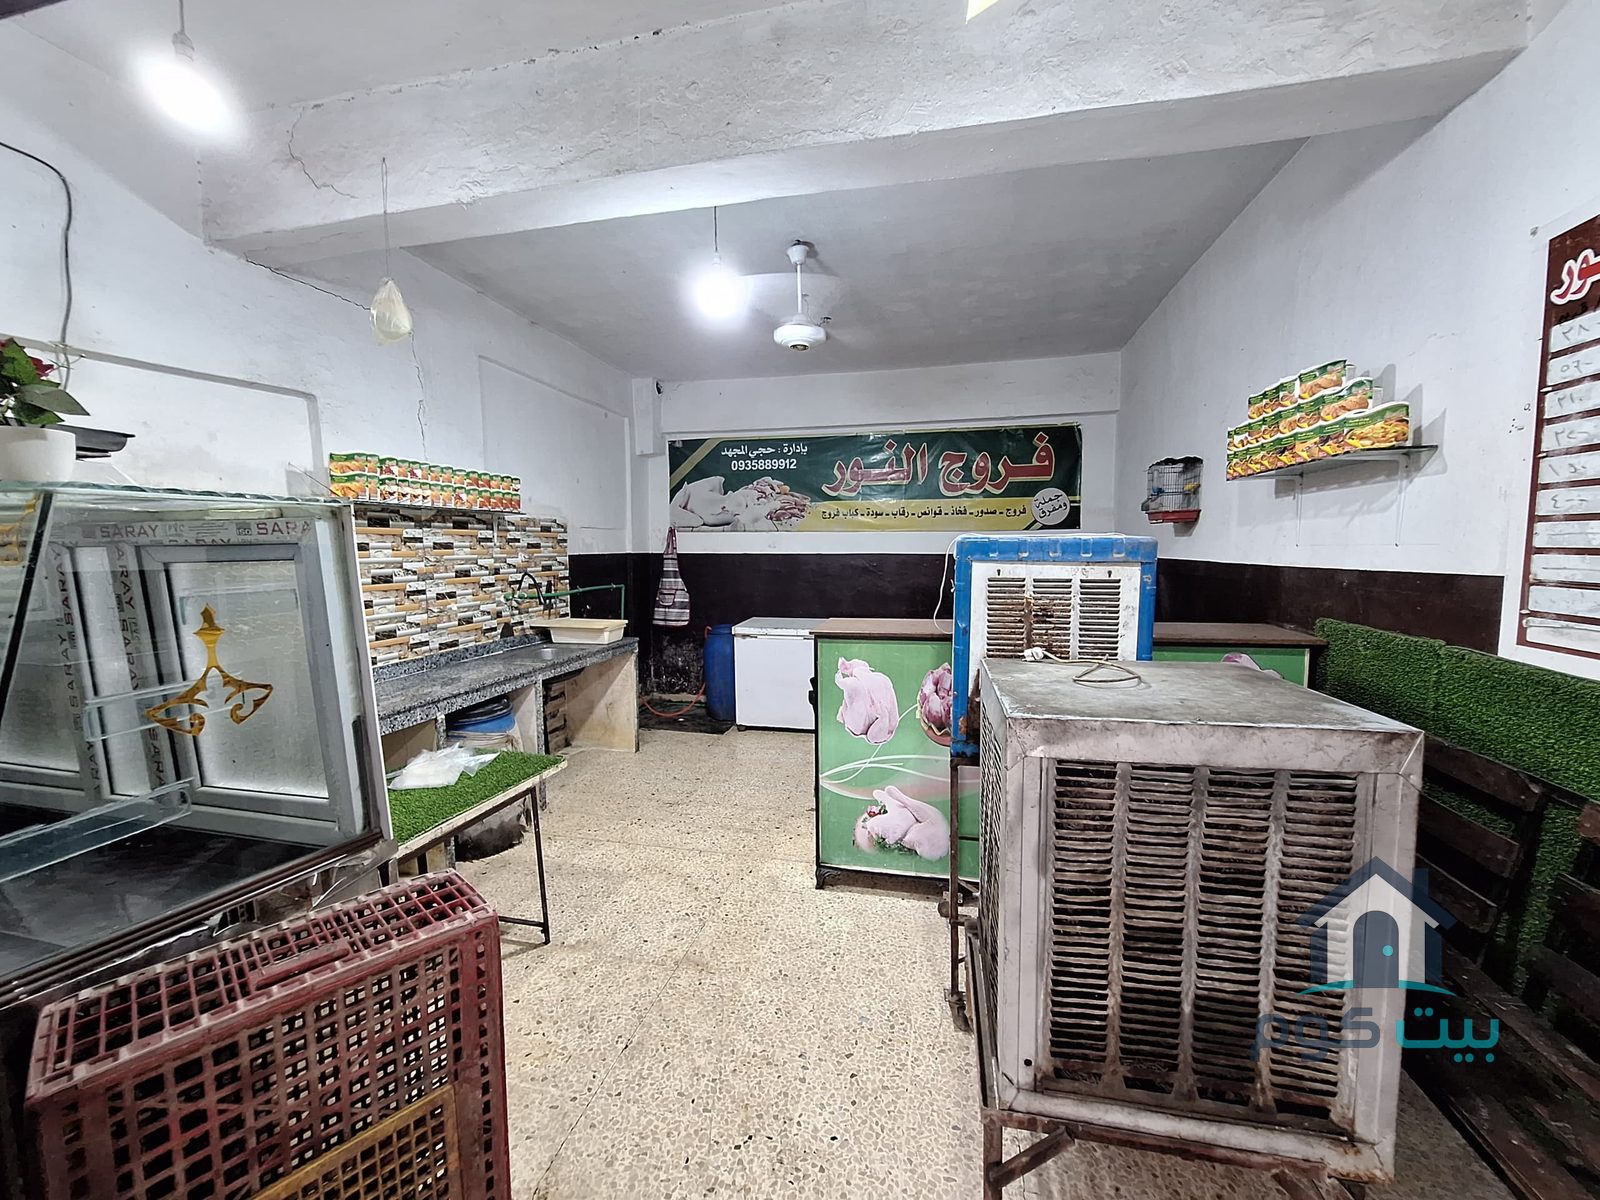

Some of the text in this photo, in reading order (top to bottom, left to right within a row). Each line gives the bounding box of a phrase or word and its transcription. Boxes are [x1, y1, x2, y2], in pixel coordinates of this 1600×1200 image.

[731, 458, 797, 471] 0935889912
[821, 432, 1055, 496] فروج النور
[821, 508, 841, 520] فروج
[842, 508, 860, 518] كباب
[865, 507, 884, 517] سودة
[891, 507, 910, 518] رقاب
[950, 507, 968, 516] فخاذ
[974, 508, 997, 518] صدور
[1005, 506, 1027, 518] فروج
[1038, 501, 1068, 519] ومفرق
[100, 524, 159, 538] SARAY
[256, 521, 312, 537] SARA
